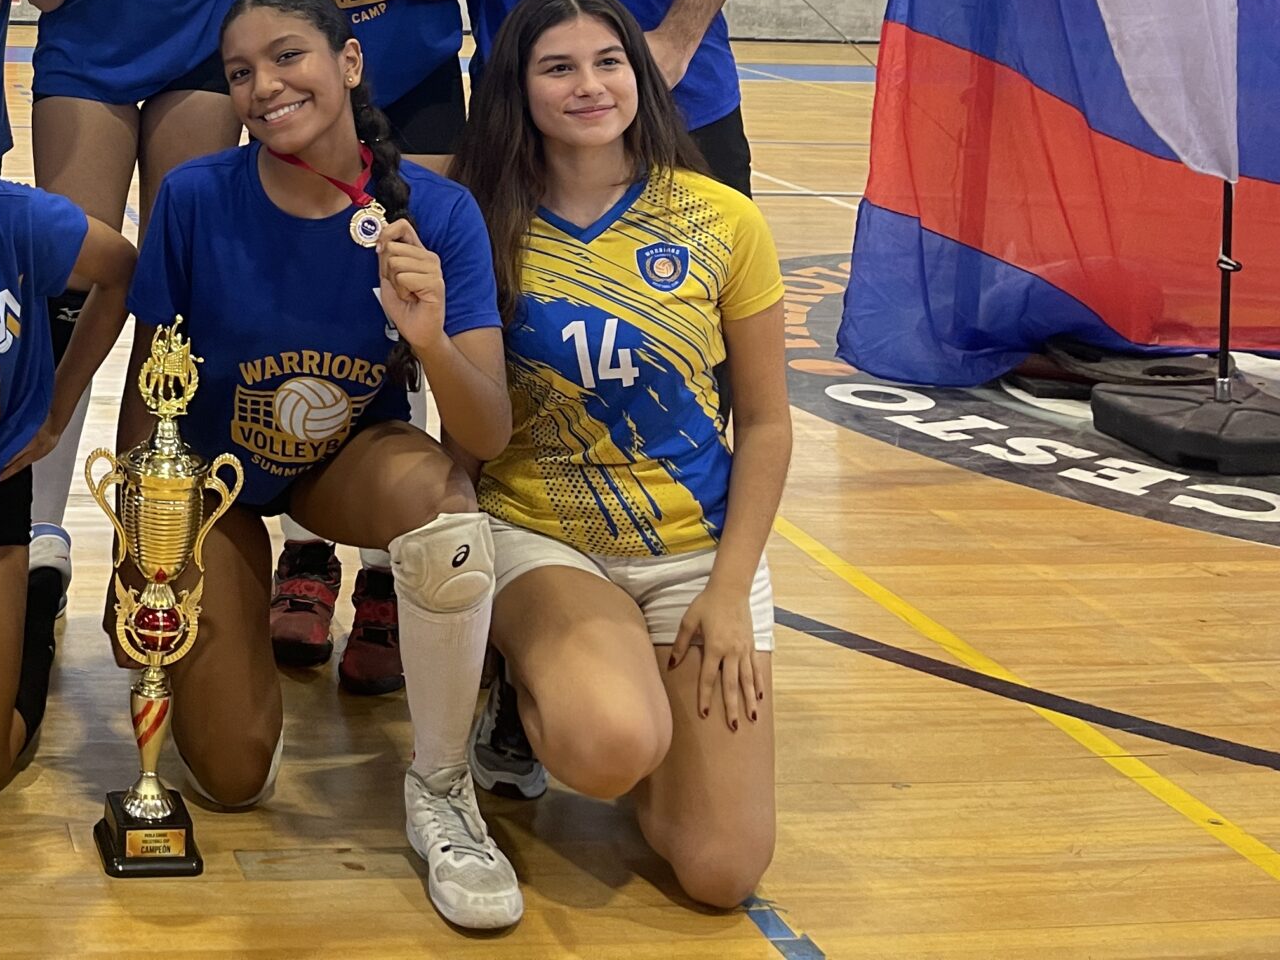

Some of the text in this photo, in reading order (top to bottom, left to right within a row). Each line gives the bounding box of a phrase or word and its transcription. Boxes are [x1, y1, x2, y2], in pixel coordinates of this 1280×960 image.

[351, 2, 387, 24] CAMP
[238, 349, 387, 388] WARRIORS
[561, 317, 640, 389] 14
[239, 426, 339, 458] VOLLEYB
